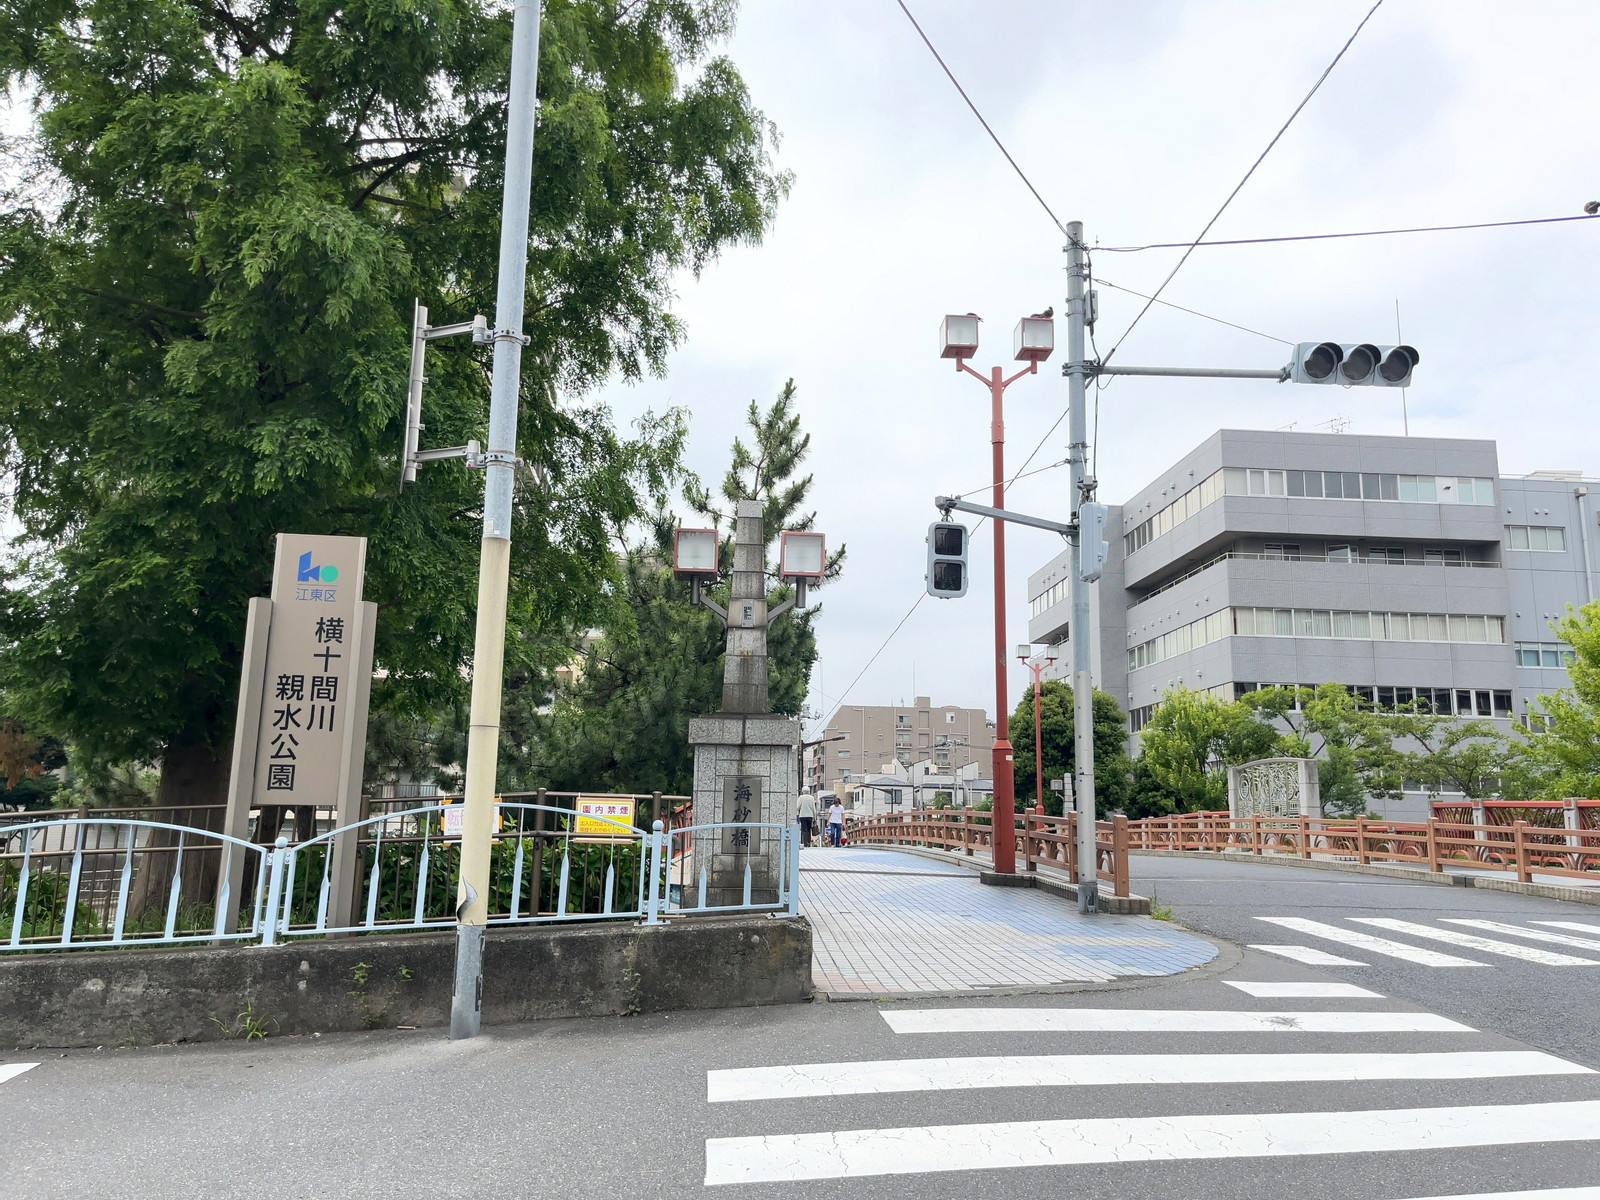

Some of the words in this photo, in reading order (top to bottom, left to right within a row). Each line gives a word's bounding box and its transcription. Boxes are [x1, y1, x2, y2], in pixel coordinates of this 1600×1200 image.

[295, 587, 337, 602] 江東区
[306, 616, 344, 732] 横十間川
[267, 674, 305, 791] 親水公園
[582, 805, 629, 815] 園内禁煙
[730, 784, 753, 848] 海砂橋
